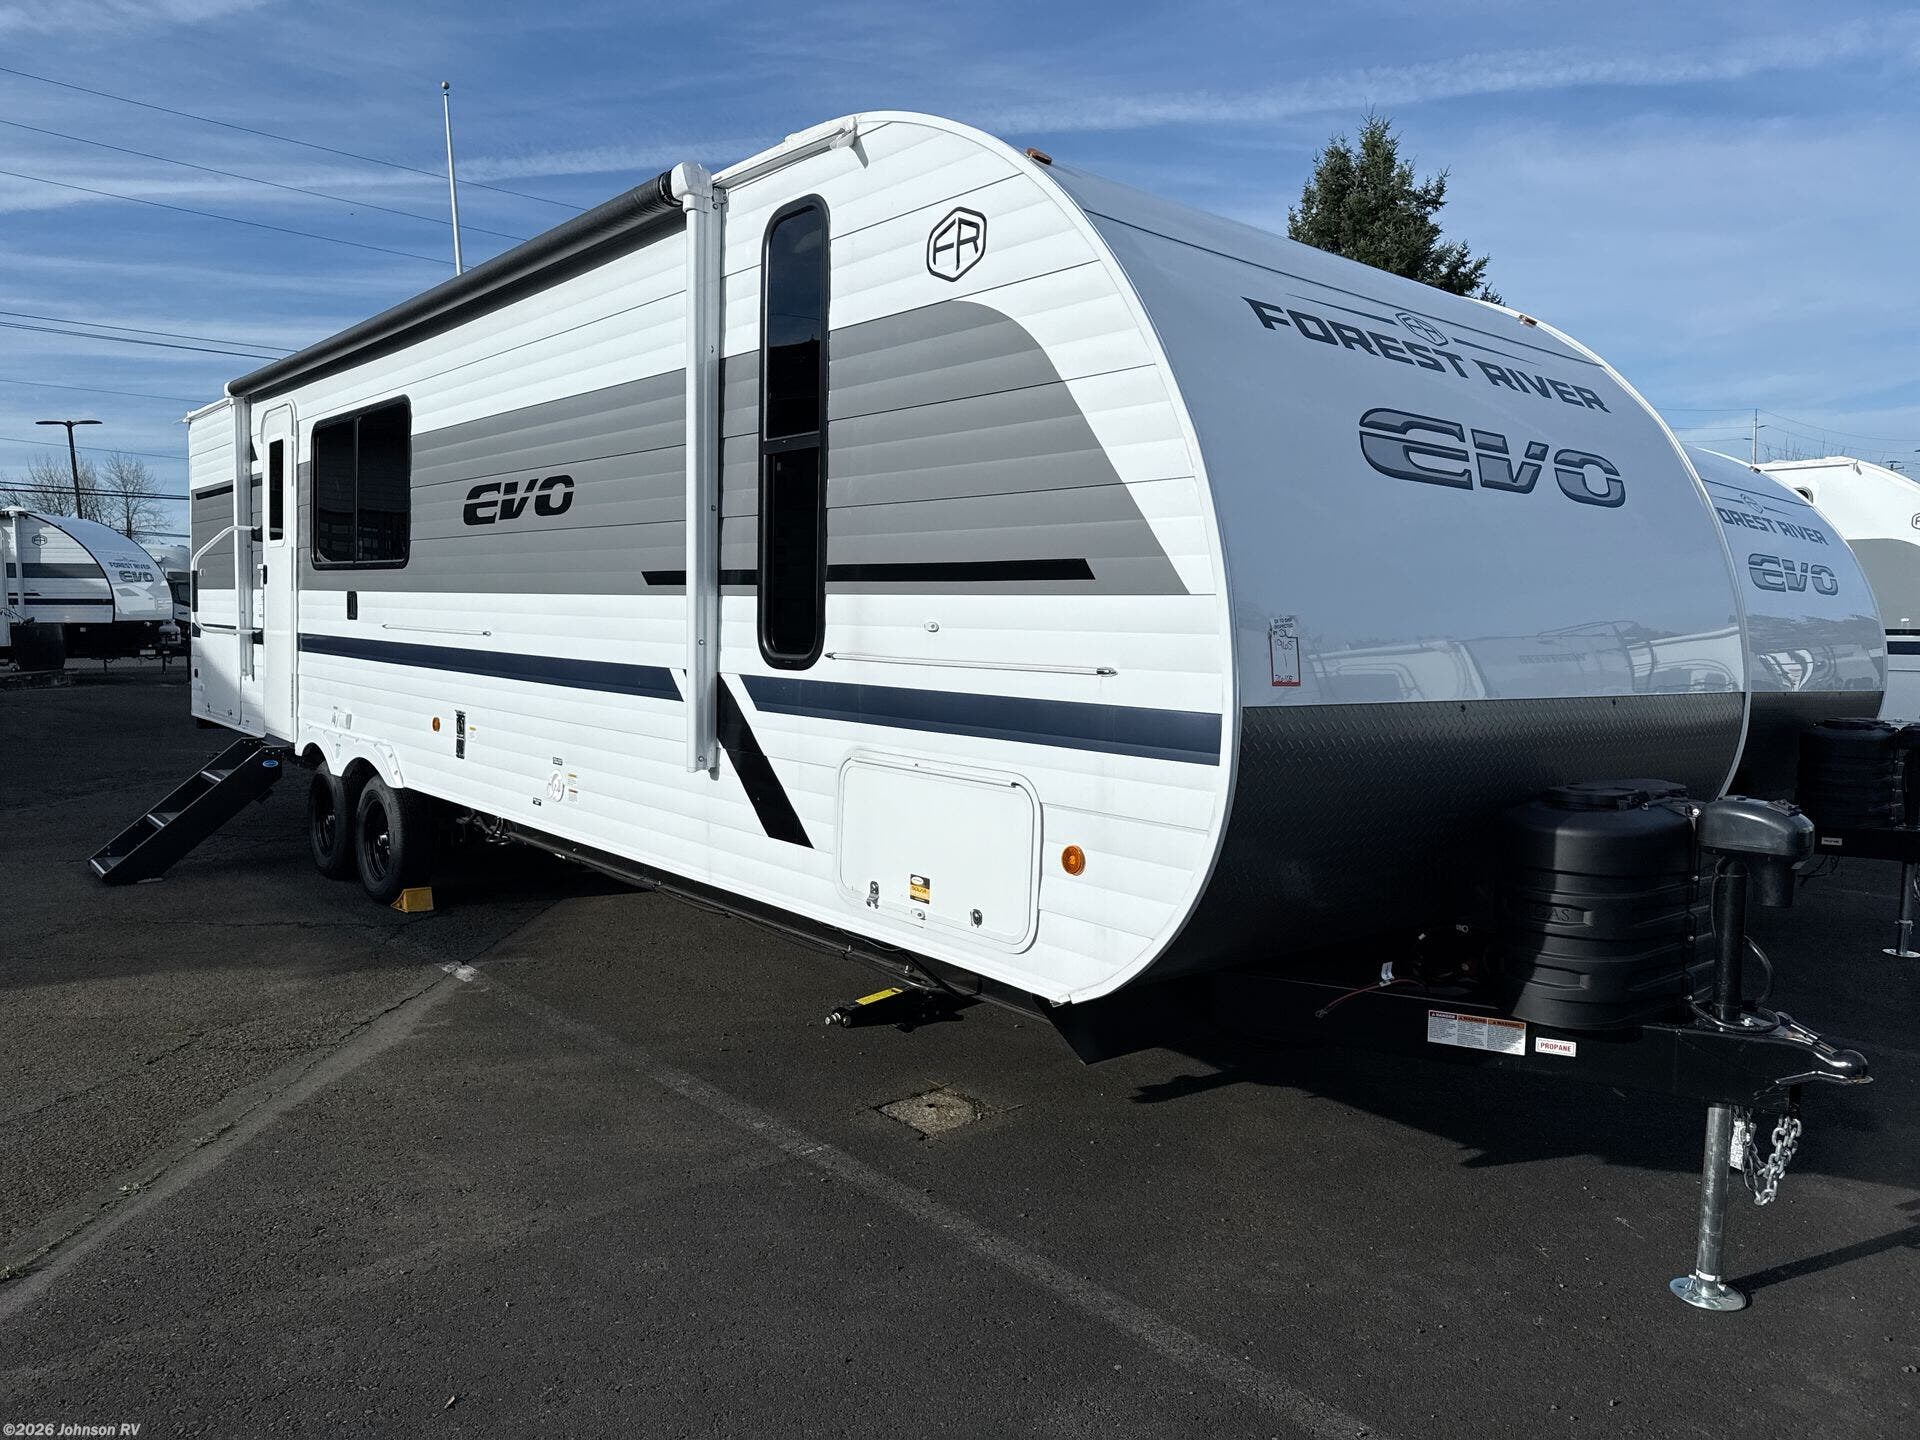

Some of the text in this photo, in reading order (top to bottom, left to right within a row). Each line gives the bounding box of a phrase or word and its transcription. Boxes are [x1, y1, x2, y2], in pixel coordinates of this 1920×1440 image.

[1241, 296, 1612, 414] FOREST RIVER
[1358, 406, 1627, 509] EVO
[463, 474, 575, 526] EVO
[1715, 507, 1830, 546] OREST RIVER
[118, 570, 155, 583] EVO
[1747, 553, 1839, 596] EVO
[1540, 1041, 1572, 1053] PROPANE
